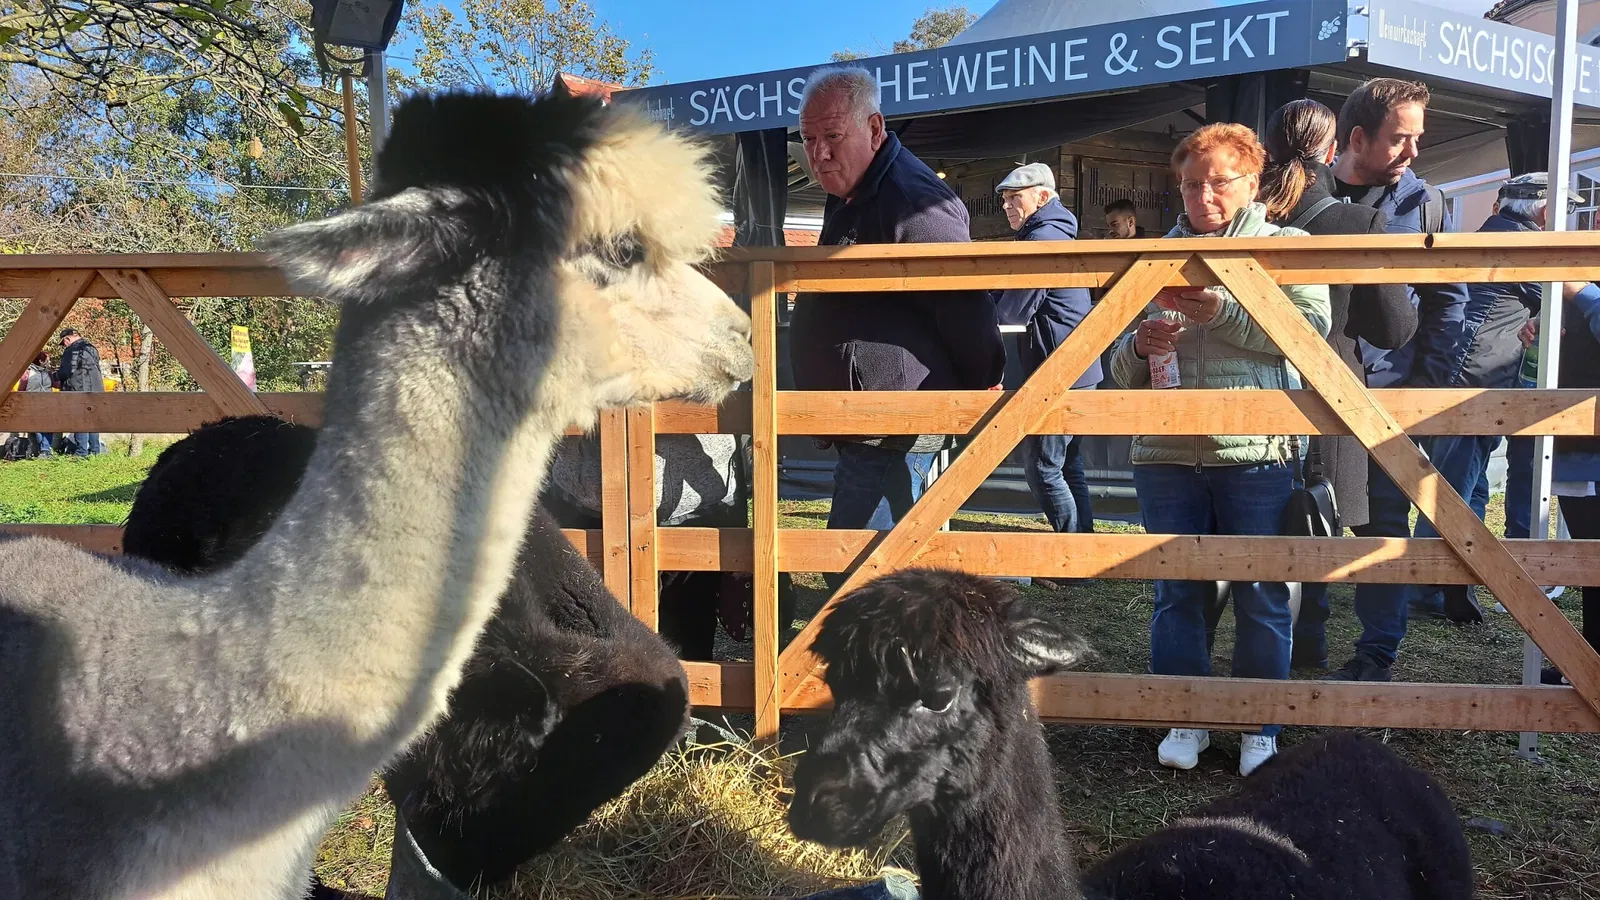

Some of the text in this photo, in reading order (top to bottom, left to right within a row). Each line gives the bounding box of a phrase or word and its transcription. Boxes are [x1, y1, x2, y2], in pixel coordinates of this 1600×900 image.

[689, 60, 929, 126] SÄCHSHE
[942, 38, 1088, 95] WEINE
[1105, 32, 1138, 75] &
[1155, 10, 1290, 69] SEKT
